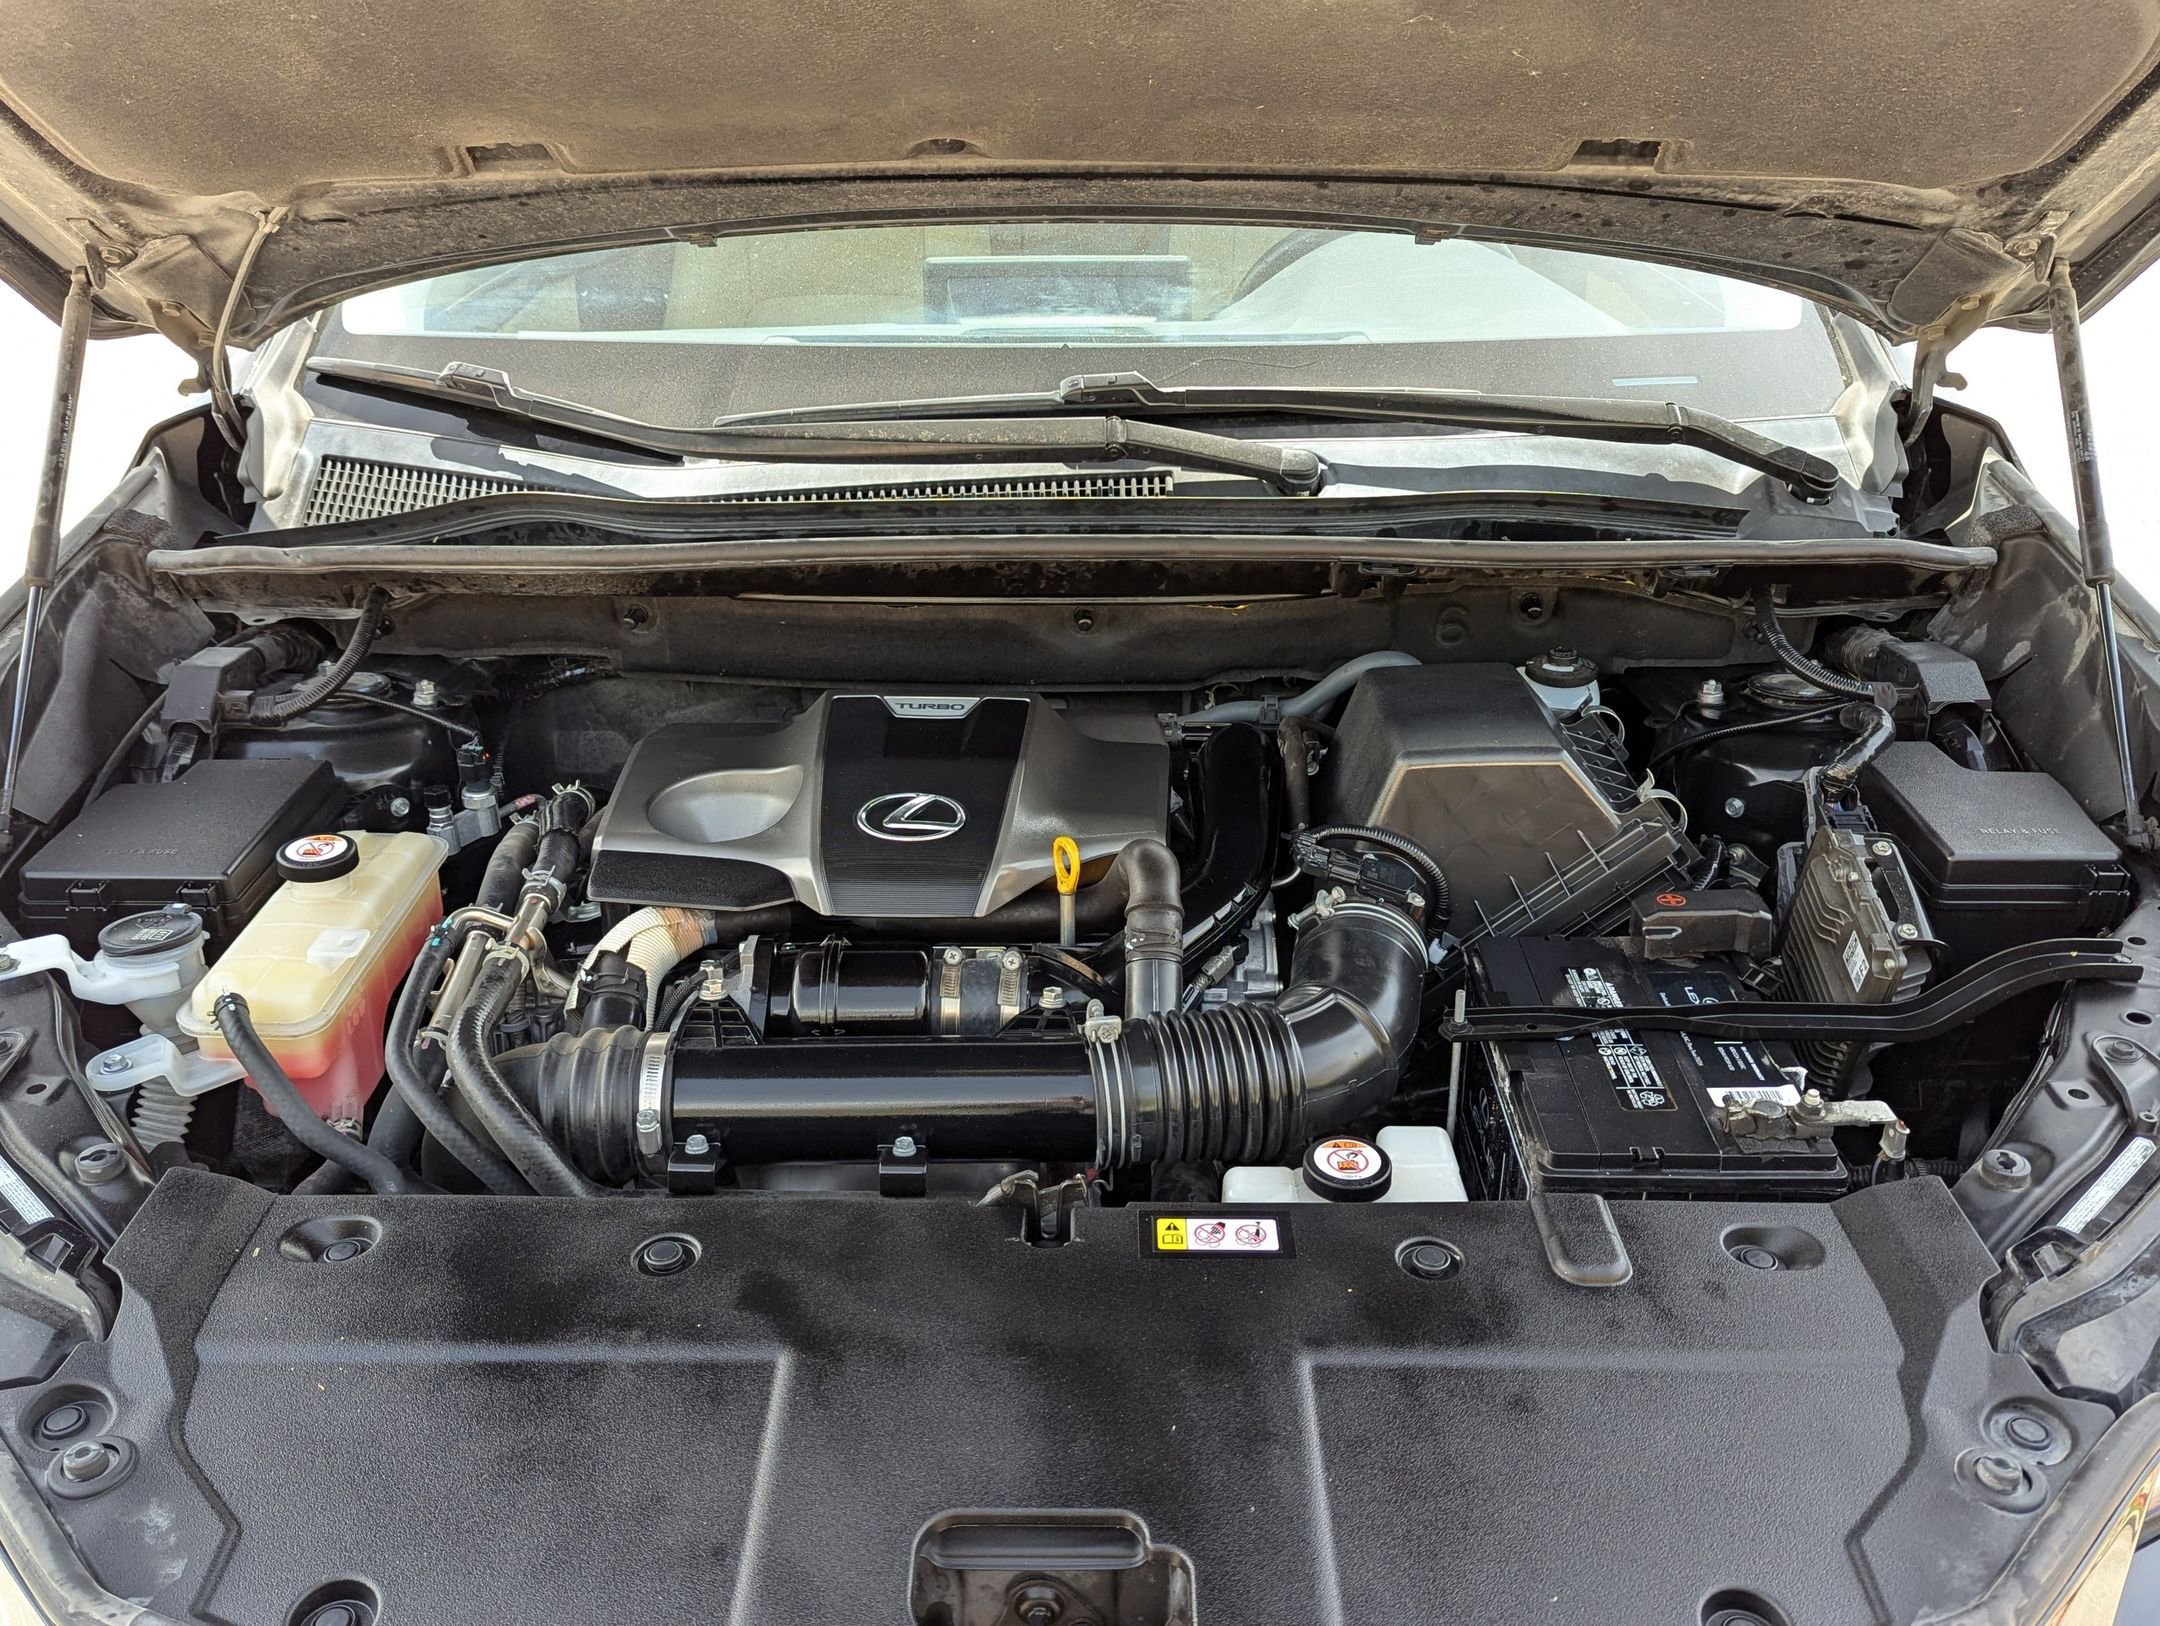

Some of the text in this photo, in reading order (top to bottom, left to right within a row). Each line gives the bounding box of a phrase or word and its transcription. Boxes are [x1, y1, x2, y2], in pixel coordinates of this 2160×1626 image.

[895, 702, 965, 711] TURBO
[1979, 827, 2017, 835] RELAY
[2031, 827, 2061, 835] FUSE
